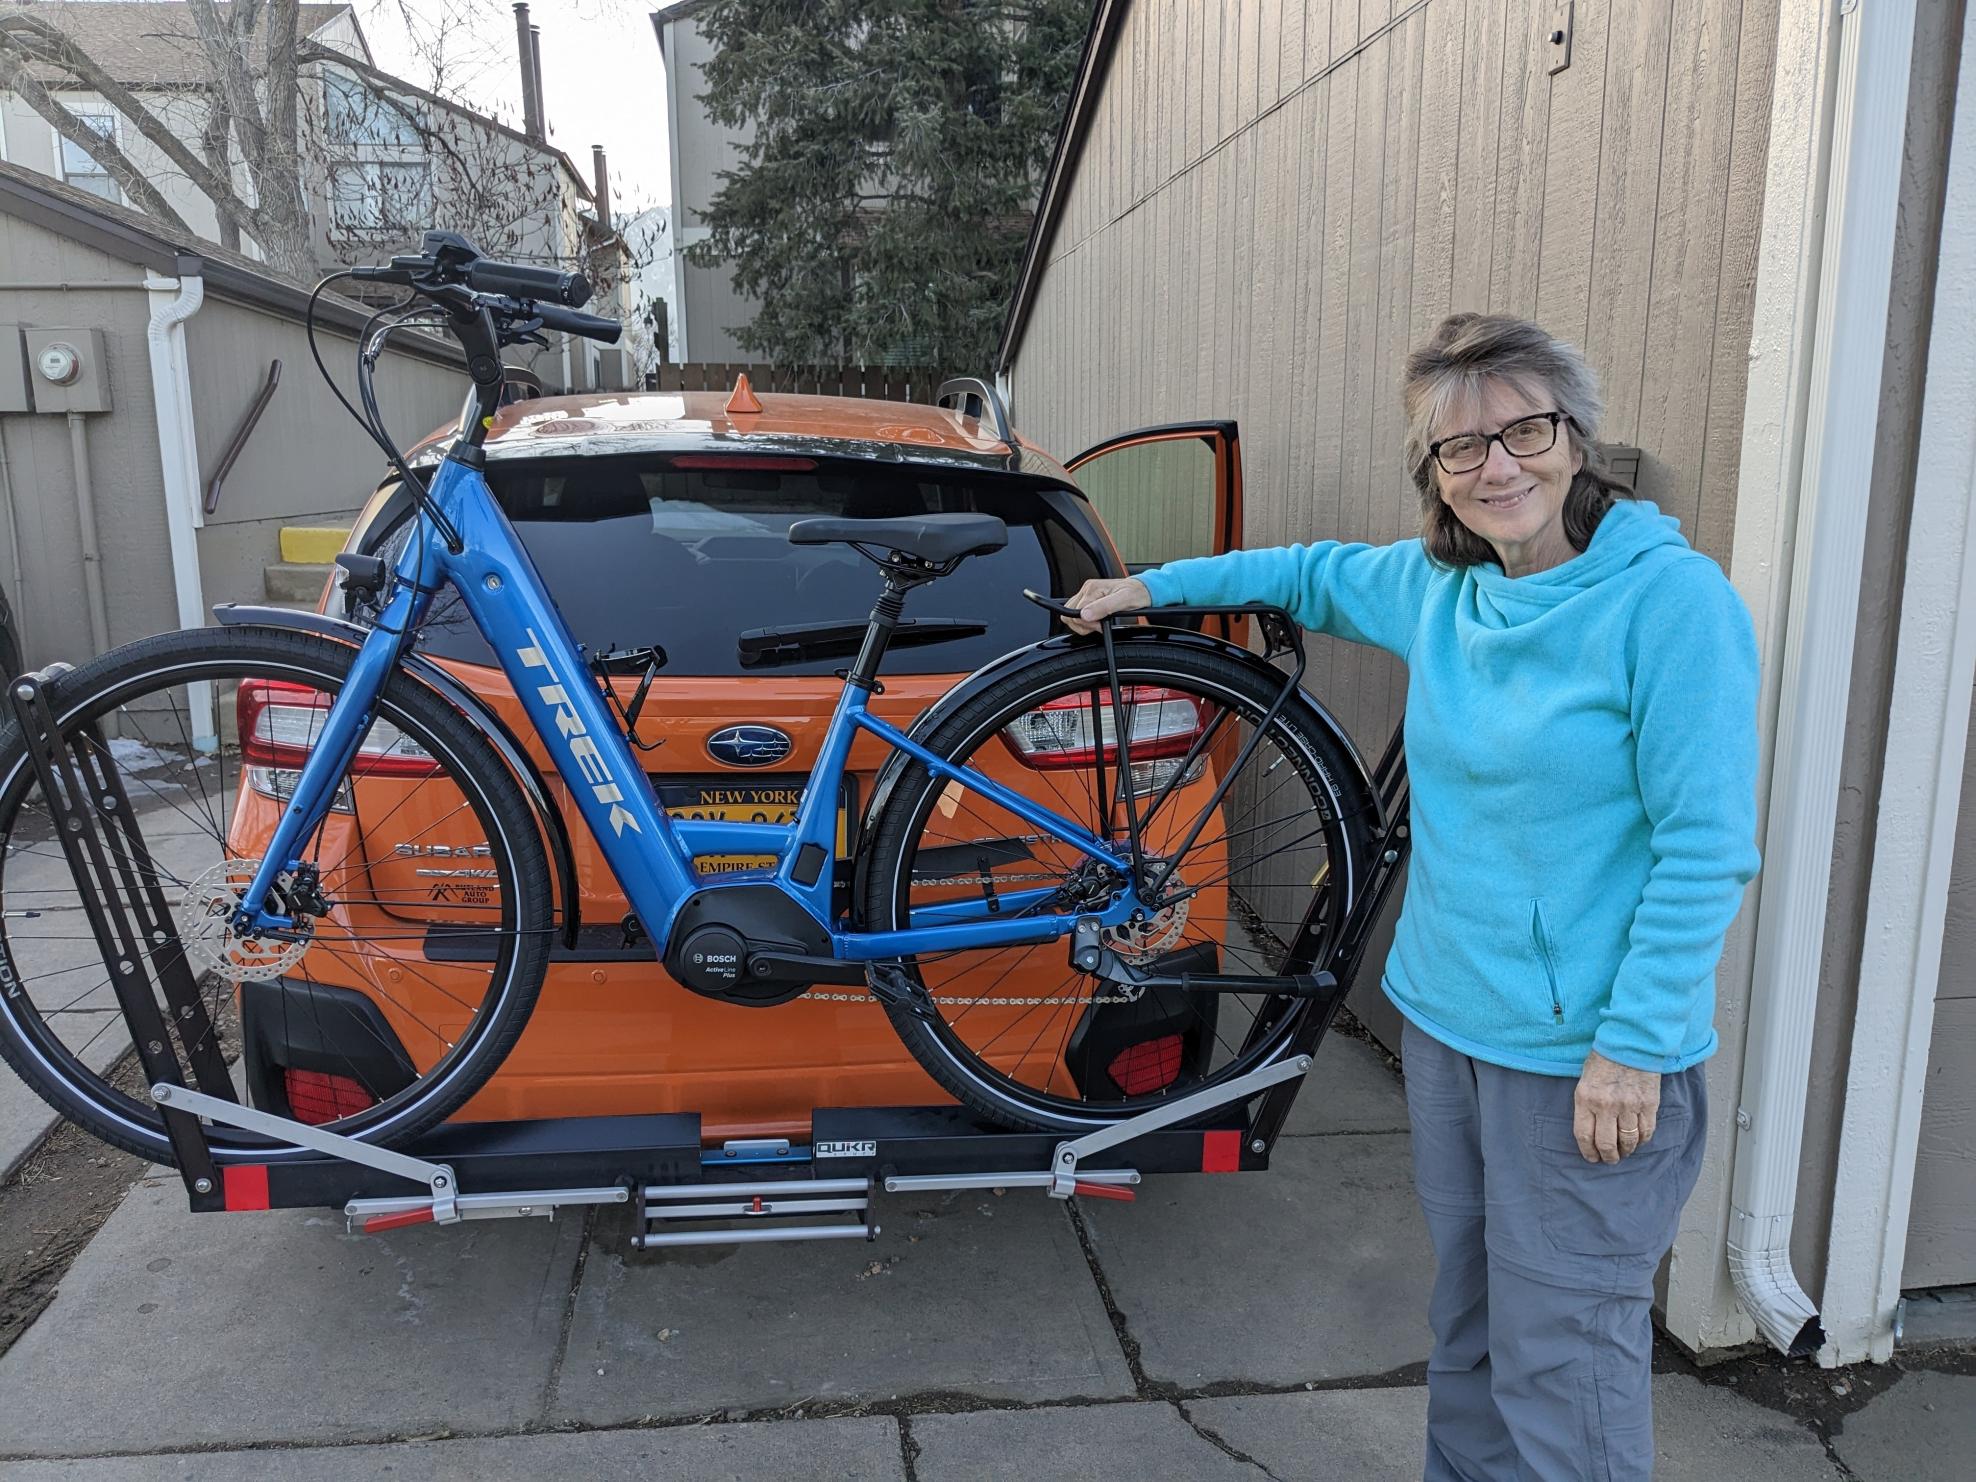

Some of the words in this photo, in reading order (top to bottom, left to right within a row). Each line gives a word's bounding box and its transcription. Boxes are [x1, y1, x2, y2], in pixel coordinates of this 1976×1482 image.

[517, 628, 642, 839] TREK
[1236, 705, 1328, 810] CONNECTON
[700, 790, 746, 805] NEW
[750, 790, 799, 804] YORK
[395, 843, 492, 857] SUBAR
[706, 955, 737, 963] BOSCH
